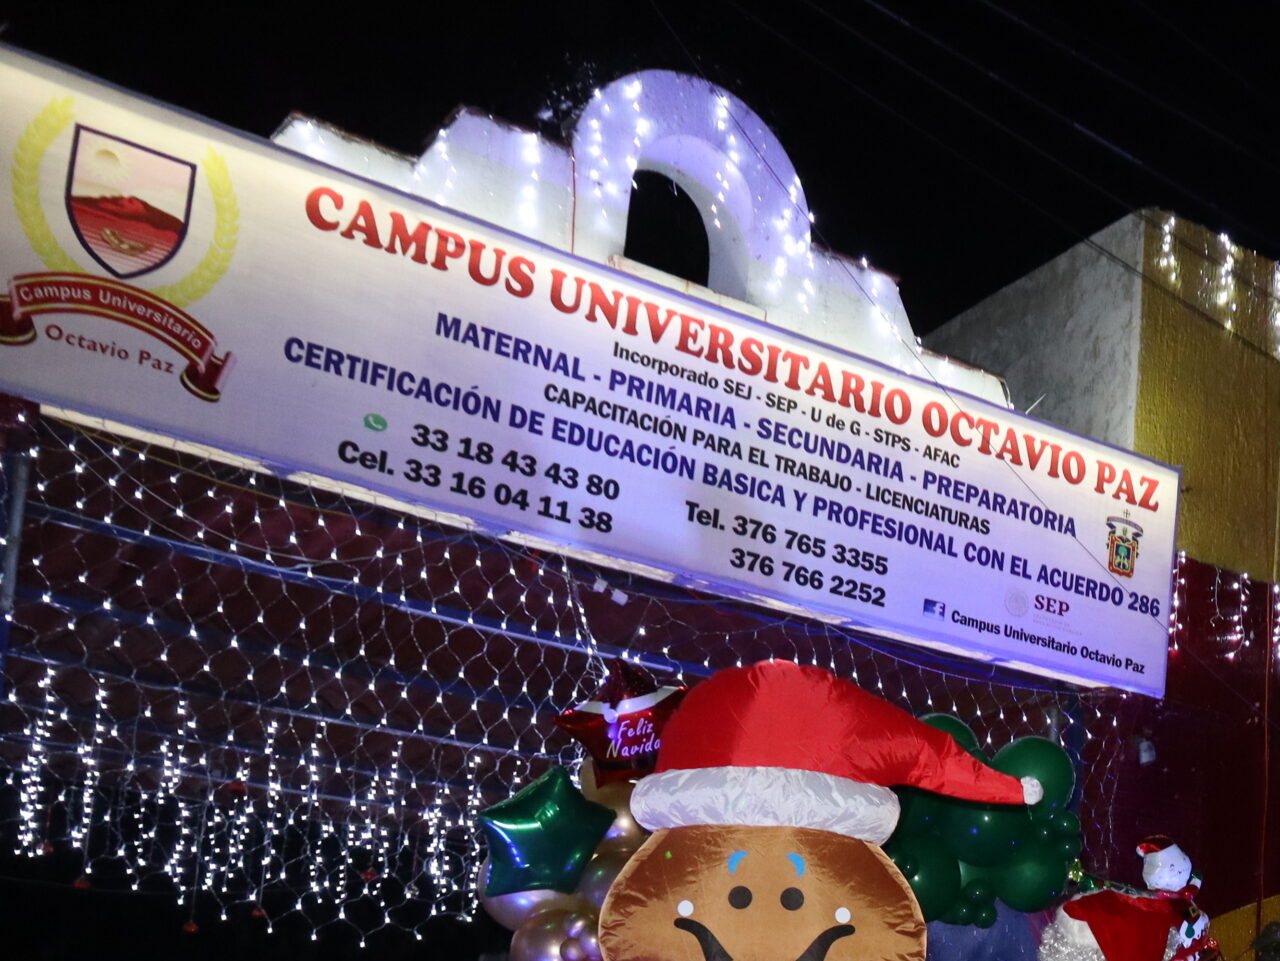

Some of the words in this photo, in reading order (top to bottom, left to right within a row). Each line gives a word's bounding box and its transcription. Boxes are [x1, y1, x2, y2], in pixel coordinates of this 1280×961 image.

[19, 284, 92, 300] Campus
[99, 289, 202, 349] Universitario
[45, 324, 130, 360] Octavio
[138, 351, 174, 374] Paz
[305, 186, 536, 298] CAMPUS
[549, 268, 912, 425] UNIVERSITARIO
[922, 401, 1086, 485] OCTAVIO
[1094, 459, 1160, 512] PAZ
[435, 311, 586, 382] MATERNAL
[608, 368, 737, 431] PRIMARIA
[756, 417, 904, 482] SECUNDARIA
[922, 469, 1077, 539] PREPARATORIA
[612, 341, 719, 390] Incorporado
[722, 378, 752, 400] SEJ
[765, 392, 798, 414] SEP
[810, 406, 822, 423] U
[825, 413, 846, 431] de
[849, 419, 862, 437] G
[873, 427, 911, 452] STPS
[923, 444, 961, 469] AFAC
[284, 336, 502, 423] CERTIFICACIÓN
[508, 403, 544, 436] DE
[551, 416, 696, 481] EDUCACIÓN
[702, 462, 786, 508] BASICA
[792, 488, 808, 513] Y
[812, 495, 958, 558] PROFESIONAL
[963, 541, 1005, 572] CON
[1010, 555, 1032, 580] EL
[1036, 564, 1124, 606] ACUERDO
[1127, 591, 1161, 618] 286
[337, 439, 395, 475] Cel.
[403, 458, 442, 488] 33
[449, 471, 486, 499] 16
[493, 483, 530, 512] 04
[536, 496, 572, 524] 11
[578, 507, 614, 534] 38
[411, 423, 450, 452] 33
[457, 437, 494, 465] 18
[501, 449, 538, 478] 43
[544, 462, 580, 490] 43
[585, 474, 621, 501] 80
[543, 383, 687, 443] CAPACITACIÓN
[692, 430, 743, 461] PARA
[748, 446, 770, 468] EL
[774, 454, 853, 493] TRABAJO
[865, 482, 991, 535] LICENCIATURAS
[685, 500, 726, 531] Tel.
[732, 514, 777, 545] 376
[784, 529, 826, 558] 765
[832, 544, 889, 576] 3355
[729, 547, 775, 577] 376
[781, 561, 824, 591] 766
[829, 575, 886, 608] 2252
[1034, 593, 1070, 617] SEP
[951, 609, 1001, 636] Campus
[1003, 624, 1078, 656] Universitario
[1080, 646, 1122, 669] Octavio
[1124, 658, 1145, 675] Paz
[617, 717, 654, 740] Feliz
